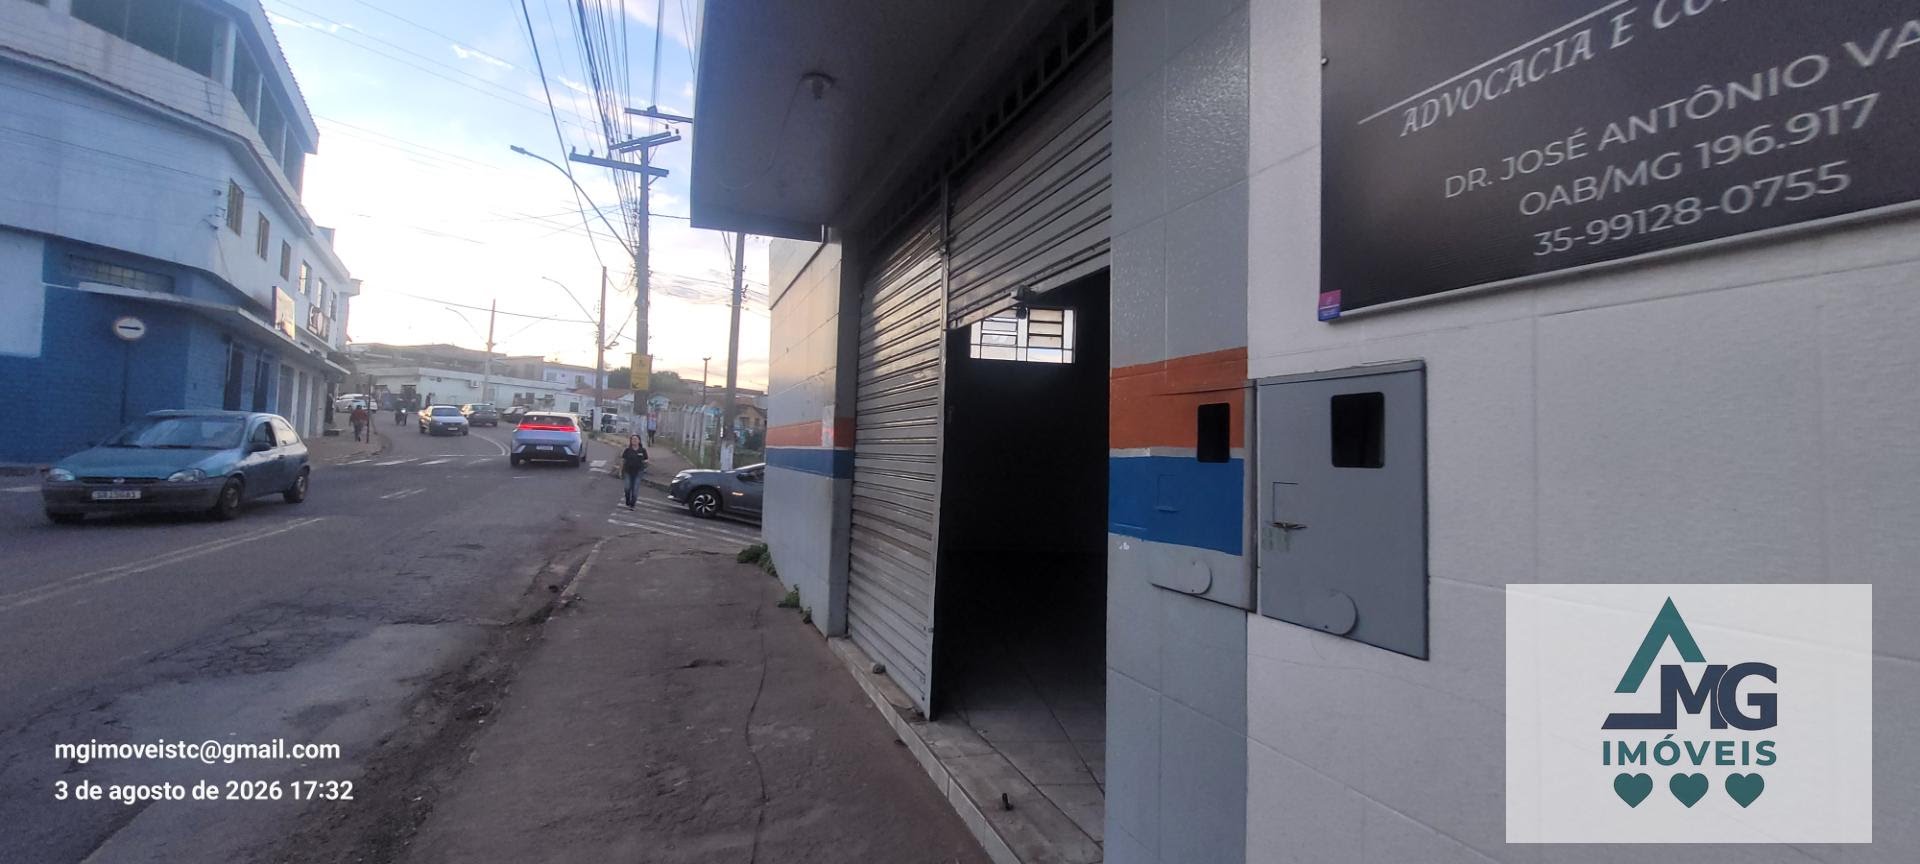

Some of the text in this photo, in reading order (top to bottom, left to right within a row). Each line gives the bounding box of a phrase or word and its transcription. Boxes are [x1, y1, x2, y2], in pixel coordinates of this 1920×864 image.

[1400, 28, 1596, 138] ADVOCACIA
[1609, 7, 1638, 50] E
[1444, 167, 1494, 198] DR.
[1500, 127, 1589, 181] JOSÉ
[1598, 54, 1830, 151] ANTÔNIO
[1519, 92, 1881, 216] OAB/MG 196.917
[1533, 160, 1851, 256] 35-99128-0755
